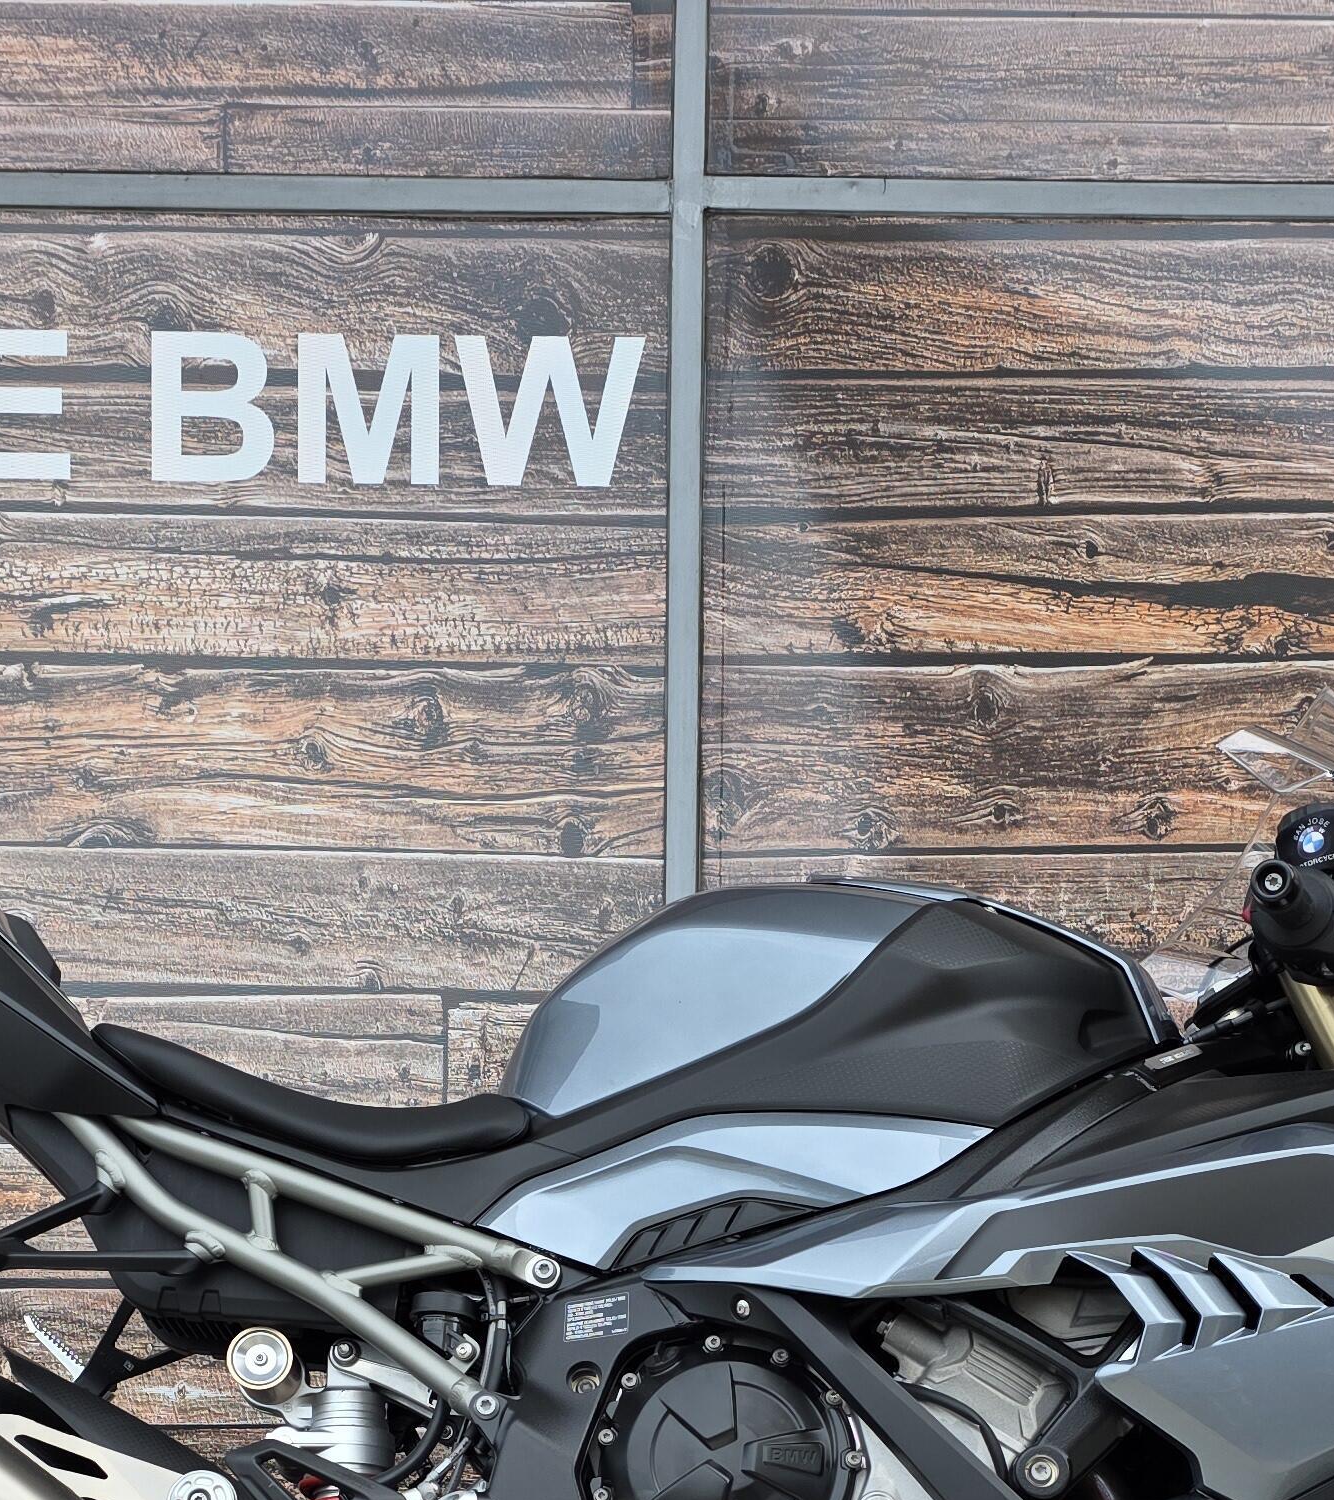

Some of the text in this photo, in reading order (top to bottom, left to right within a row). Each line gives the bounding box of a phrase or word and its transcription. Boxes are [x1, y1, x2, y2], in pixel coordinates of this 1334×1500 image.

[151, 330, 646, 487] BMW
[1293, 817, 1330, 841] SAN JOSE
[771, 1447, 819, 1465] BMW
